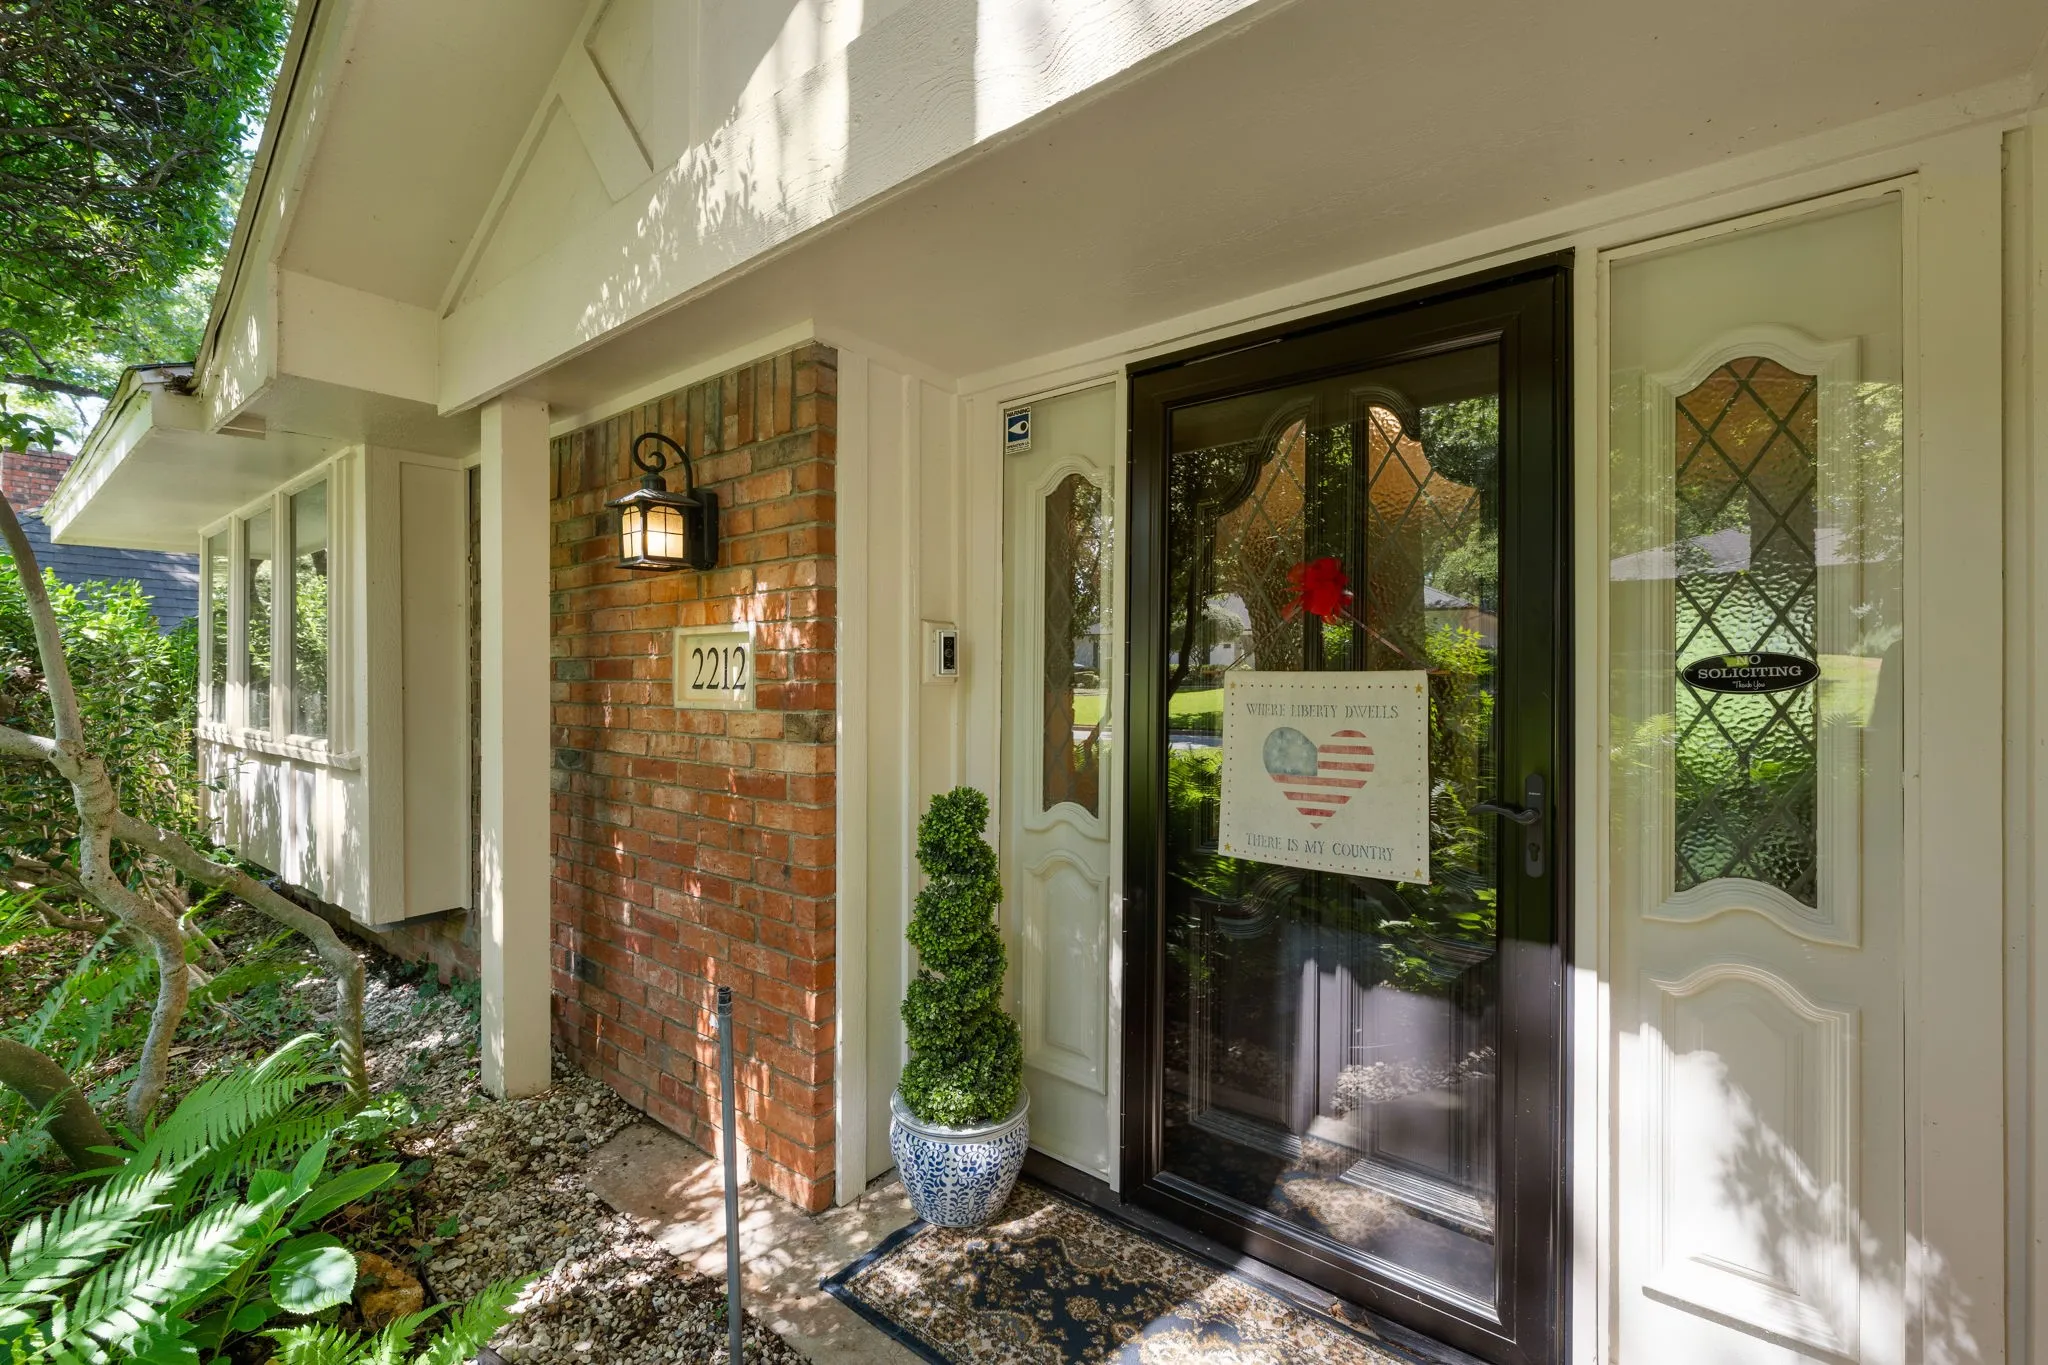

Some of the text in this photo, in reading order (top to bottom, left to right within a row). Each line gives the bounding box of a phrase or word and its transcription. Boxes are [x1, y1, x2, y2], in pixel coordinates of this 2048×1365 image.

[691, 646, 747, 690] 2212
[1735, 654, 1762, 666] NO
[1697, 665, 1803, 680] SOLICITING
[1752, 680, 1766, 691] You
[1246, 703, 1400, 720] WHERE LIBERTY DWELLS
[1245, 832, 1395, 862] THERE IS MY COUNTRY
